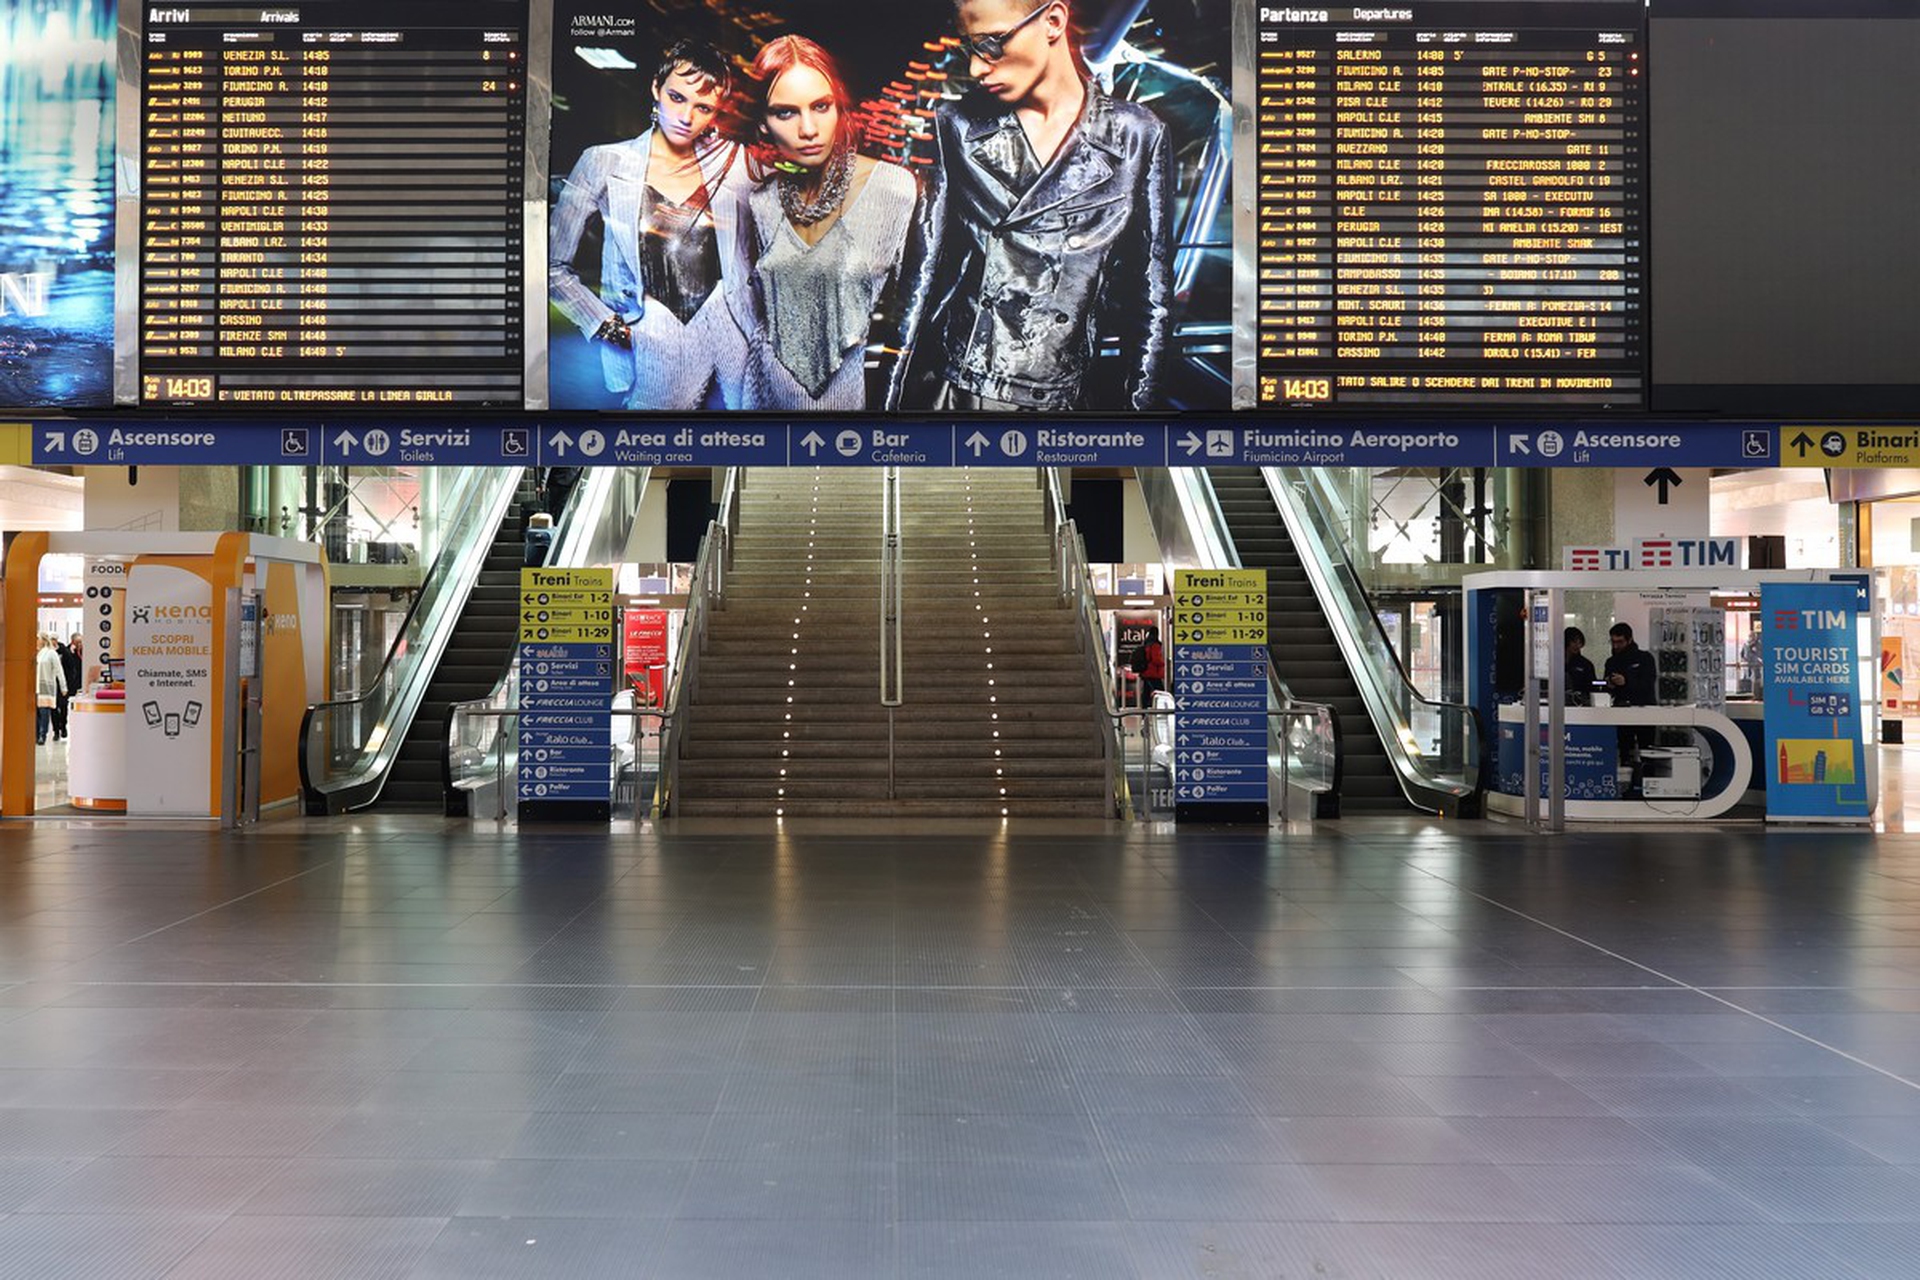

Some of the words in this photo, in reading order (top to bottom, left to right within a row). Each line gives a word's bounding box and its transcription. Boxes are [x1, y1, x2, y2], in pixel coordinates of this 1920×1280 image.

[149, 8, 190, 22] Arrivi
[260, 11, 300, 23] Arrivals
[1260, 8, 1328, 22] Partenze
[1353, 8, 1413, 22] Departures
[571, 28, 595, 36] follow
[597, 28, 635, 36] @Armani
[223, 50, 265, 61] VENEZIA
[1337, 50, 1381, 61] SALERNO
[1337, 66, 1388, 76] FIUMICINO
[1482, 66, 1507, 77] GATE
[1598, 66, 1612, 77] 23
[223, 81, 274, 92] FIUMICINO
[482, 82, 496, 92] 24
[222, 97, 265, 107] PERUGIA
[1336, 97, 1361, 107] PISA
[222, 113, 266, 123] NETTUNO
[1336, 144, 1388, 154] AVEZZANO
[1566, 145, 1592, 155] GATE
[221, 253, 264, 263] TARANTO
[219, 347, 256, 358] MILANO
[1337, 347, 1380, 358] CASSINO
[1370, 376, 1407, 388] SALIRE
[1425, 377, 1476, 388] SCENDERE
[1481, 377, 1500, 388] DAI
[1505, 377, 1535, 388] TRENI
[1540, 377, 1552, 388] IN
[1557, 377, 1613, 388] MOVIMENTO
[166, 378, 211, 398] 14:03
[1284, 379, 1330, 399] 14:03
[234, 390, 276, 401] VIETATO
[281, 390, 356, 401] OLTREPASSARE
[361, 390, 375, 401] LA
[380, 391, 410, 401] LINEA
[415, 391, 453, 401] GIALLA
[109, 429, 215, 445] Ascensore
[400, 429, 469, 446] Servizi
[615, 430, 662, 446] Area
[674, 429, 692, 446] di
[701, 432, 764, 446] attesa
[873, 430, 909, 446] Bar
[1038, 429, 1144, 446] Ristorante
[1244, 430, 1343, 446] Fiumicino
[1350, 431, 1458, 451] Aeroporto
[1573, 431, 1681, 447] Ascensore
[1858, 430, 1919, 447] Binari
[109, 448, 124, 461] Lift
[400, 449, 434, 461] Toilets
[615, 451, 658, 464] Waiting
[661, 454, 692, 464] area
[872, 449, 925, 462] Cafeteria
[1037, 451, 1097, 462] Restaurant
[1244, 450, 1293, 462] Fiumicino
[1298, 451, 1344, 465] Airport
[1574, 450, 1589, 462] Lift
[1857, 451, 1908, 463] Platforms
[1678, 541, 1734, 565] TIM
[532, 573, 571, 586] Treni
[574, 574, 603, 586] Trains
[1186, 574, 1224, 588] Treni
[1228, 576, 1257, 588] Trains
[590, 593, 609, 603] 1-2
[1244, 594, 1264, 604] 1-2
[583, 610, 610, 620] 1-10
[1237, 612, 1264, 622] 1-10
[1802, 610, 1846, 629] TIM
[577, 627, 610, 638] 11-29
[1232, 629, 1264, 639] 11-29
[151, 635, 194, 644] SCOPRI
[133, 646, 163, 655] KENA
[1774, 647, 1849, 661] TOURIST
[551, 662, 578, 670] Servizi
[1206, 664, 1234, 672] Servizi
[1775, 663, 1801, 675] SIM
[1803, 663, 1850, 675] CARDS
[137, 669, 184, 679] Chiamate,
[186, 669, 207, 678] SMS
[551, 679, 569, 687] Area
[1774, 676, 1824, 684] AVAILABLE
[1826, 676, 1851, 685] HERE
[1811, 696, 1826, 705] SIM
[1810, 706, 1824, 715] GB
[536, 716, 574, 724] FRECCIA
[574, 716, 594, 724] CLUB
[1191, 718, 1230, 726] FRECCIA
[1231, 718, 1250, 726] CLUB
